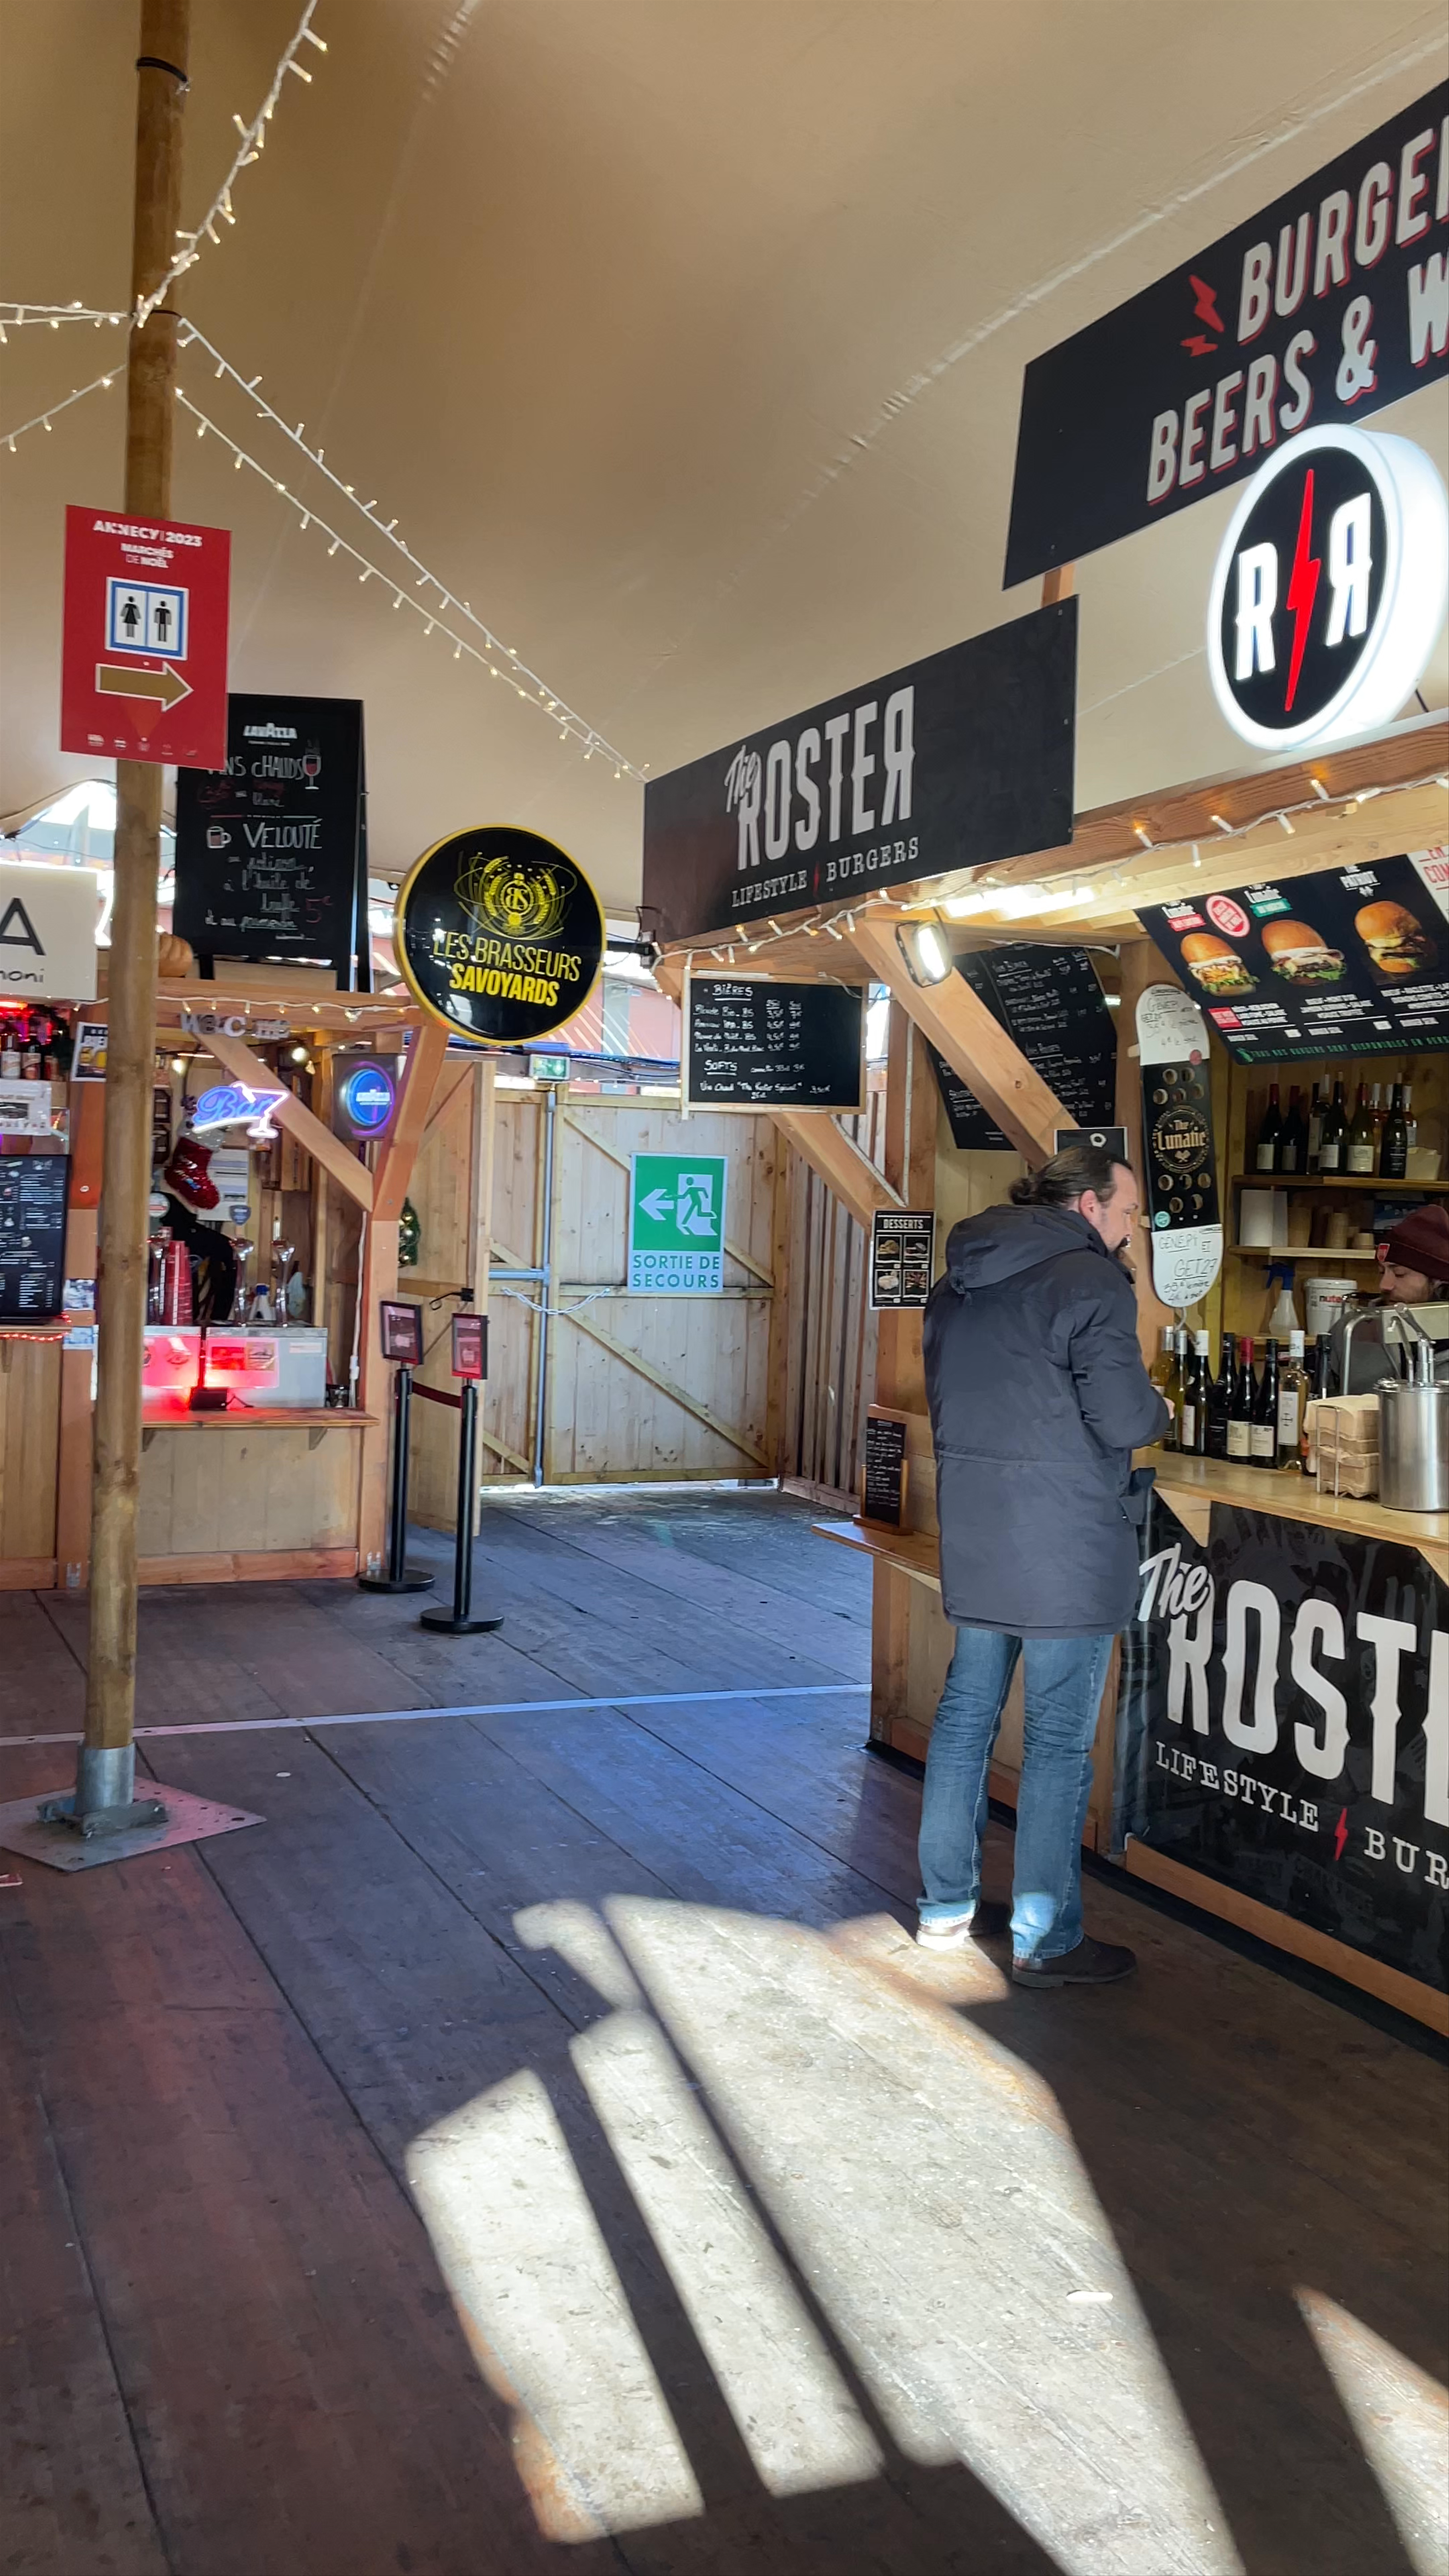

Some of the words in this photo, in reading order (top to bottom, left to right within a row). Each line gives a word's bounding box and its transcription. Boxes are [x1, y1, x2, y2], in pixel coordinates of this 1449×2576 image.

[1146, 329, 1318, 505] BEERS
[1335, 294, 1377, 406] &
[93, 520, 159, 540] ANNECY
[165, 531, 203, 547] 2023
[120, 543, 174, 559] MARCHÉS
[126, 554, 140, 564] DE
[140, 556, 169, 568] NOËL
[724, 744, 758, 813] The
[738, 685, 916, 870] ROSTER
[243, 818, 323, 849] VELOUTÉ
[732, 870, 808, 907] LIFESTYLE
[826, 837, 919, 883] BURGERS
[433, 931, 472, 960] LES
[474, 937, 581, 981] BRASSEURS
[449, 963, 560, 1007] SAVOYARDS
[193, 1087, 274, 1123] Bar
[883, 1219, 924, 1229] DESSERTS
[633, 1255, 693, 1269] SORTIE
[700, 1256, 720, 1270] DE
[633, 1273, 719, 1288] SECOURS
[1138, 1542, 1211, 1622] The
[1156, 1741, 1320, 1832] LIFESTYLE
